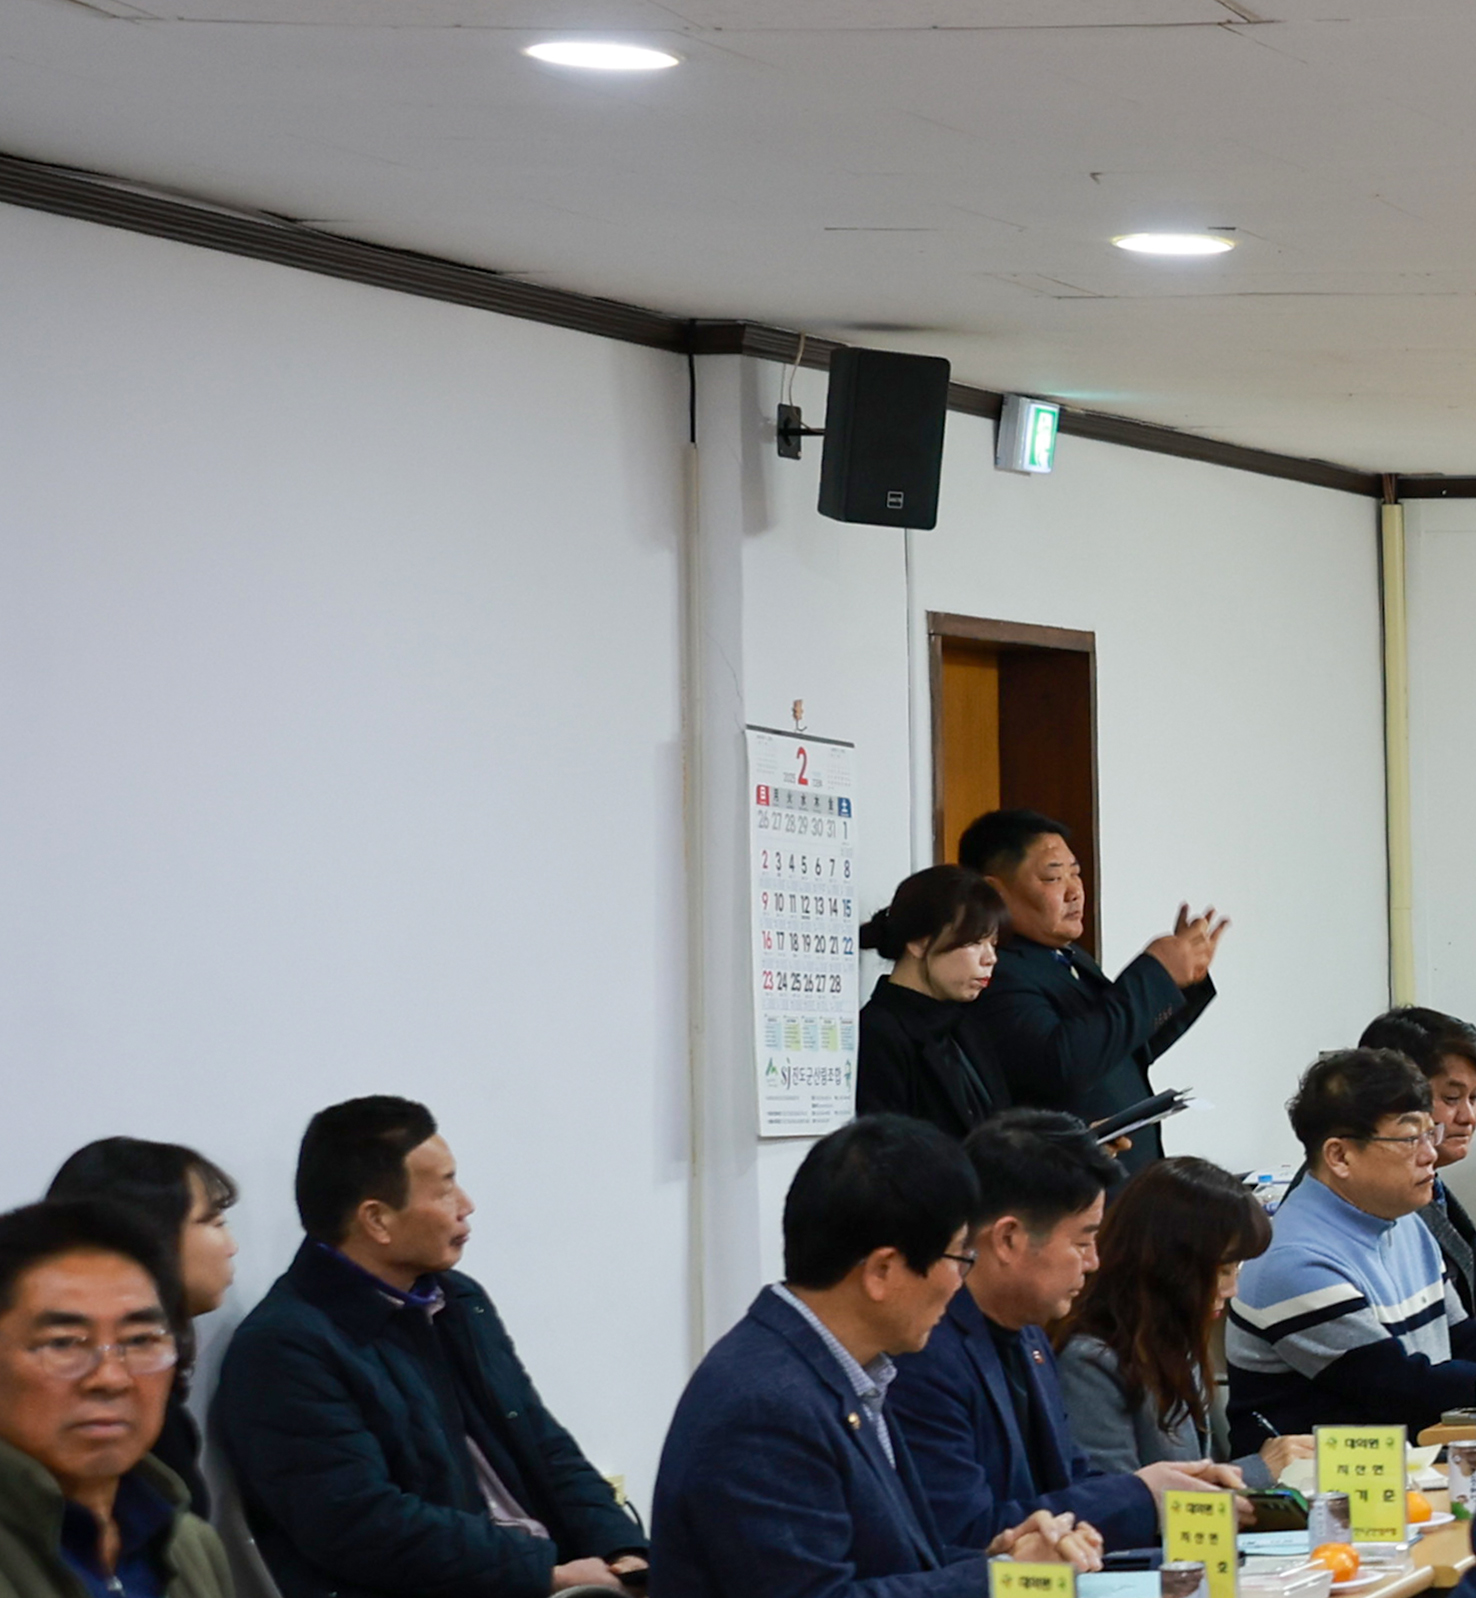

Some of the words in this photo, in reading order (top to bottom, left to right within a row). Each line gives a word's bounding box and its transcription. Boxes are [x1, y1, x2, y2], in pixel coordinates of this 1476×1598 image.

[796, 746, 808, 786] 2
[762, 850, 768, 869] 2
[776, 852, 781, 871] 3
[789, 854, 795, 872] 4
[802, 856, 807, 874] 5
[815, 858, 821, 876] 6
[830, 858, 835, 876] 7
[844, 860, 850, 878] 8
[762, 892, 768, 910] 9
[775, 893, 784, 912] 10
[789, 894, 796, 913] 11
[801, 896, 810, 914] 12
[814, 897, 824, 915] 13
[828, 898, 838, 916] 14
[842, 899, 851, 918] 15
[762, 931, 772, 949] 16
[776, 932, 784, 950] 17
[789, 932, 798, 951] 18
[802, 934, 811, 952] 19
[814, 934, 826, 953] 20
[830, 936, 839, 954] 21
[843, 936, 854, 955] 22
[762, 970, 773, 990] 23
[777, 972, 787, 990] 24
[791, 972, 801, 991] 25
[804, 974, 814, 992] 26
[816, 974, 826, 992] 27
[830, 974, 841, 993] 28
